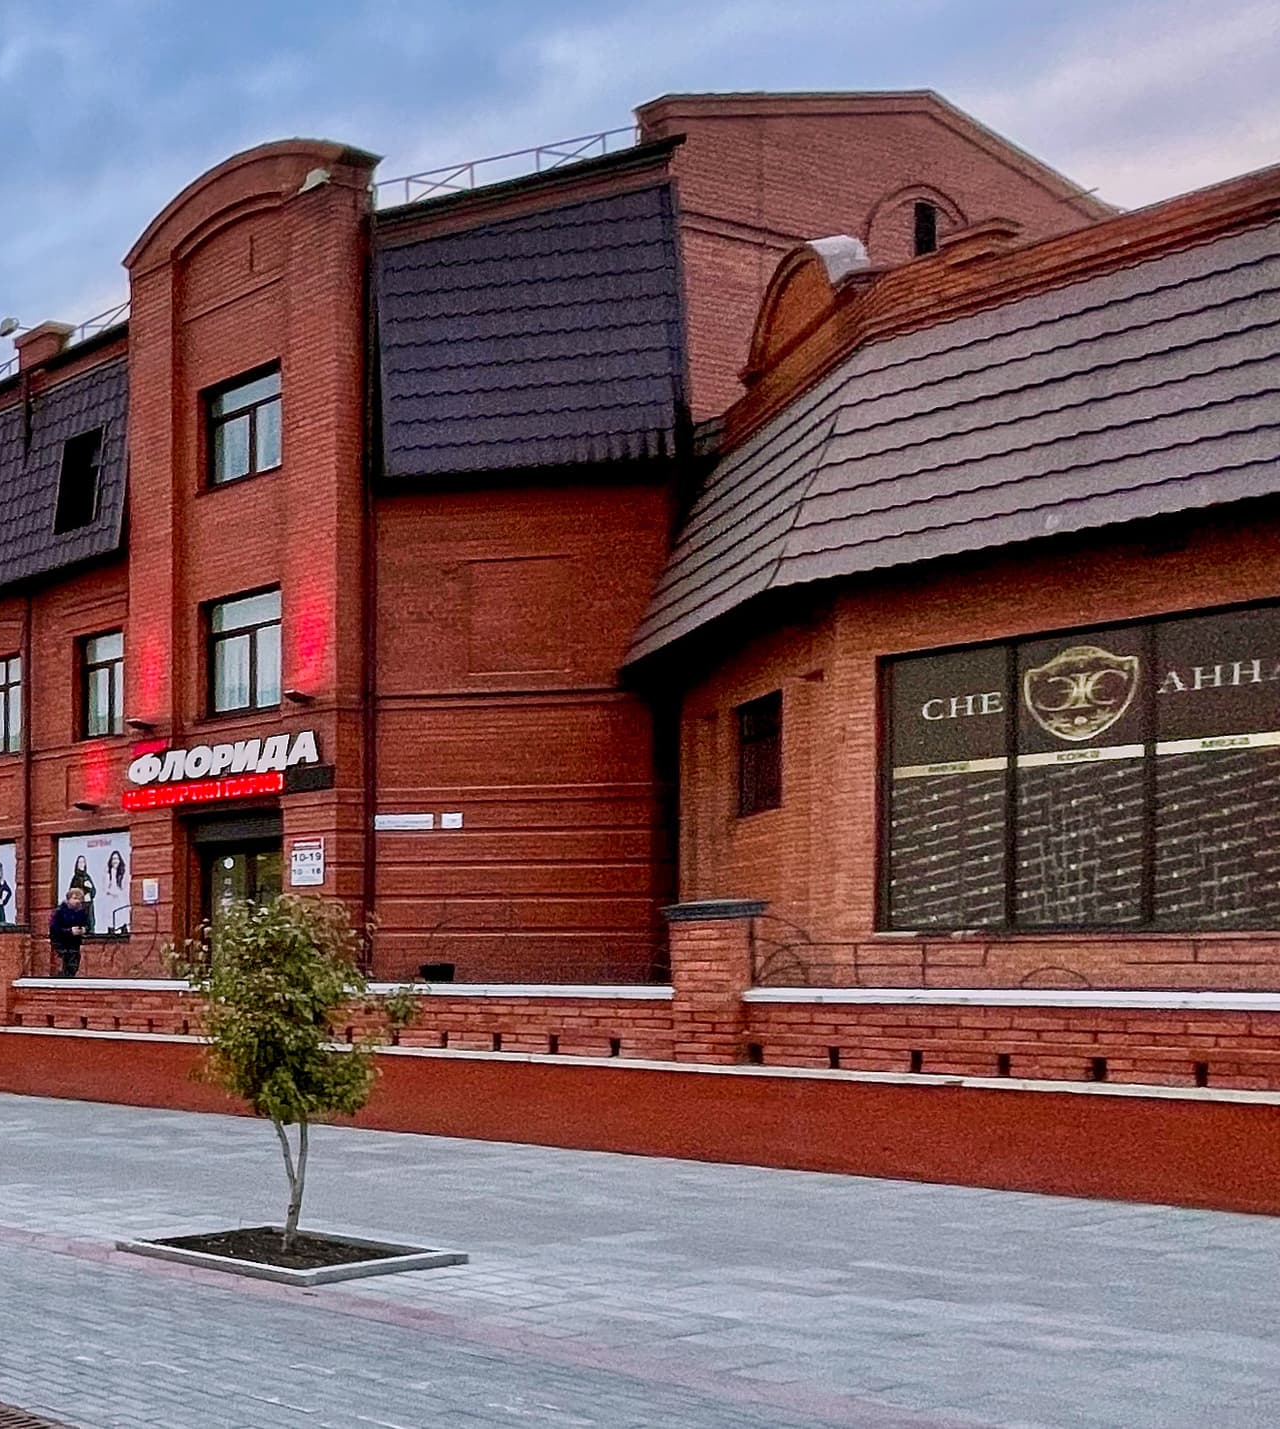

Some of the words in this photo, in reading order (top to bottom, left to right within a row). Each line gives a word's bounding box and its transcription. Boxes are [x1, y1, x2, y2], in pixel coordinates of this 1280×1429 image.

[921, 691, 1004, 721] СНЕ
[1157, 659, 1280, 694] АНН
[128, 730, 319, 785] ФЛОРИДА
